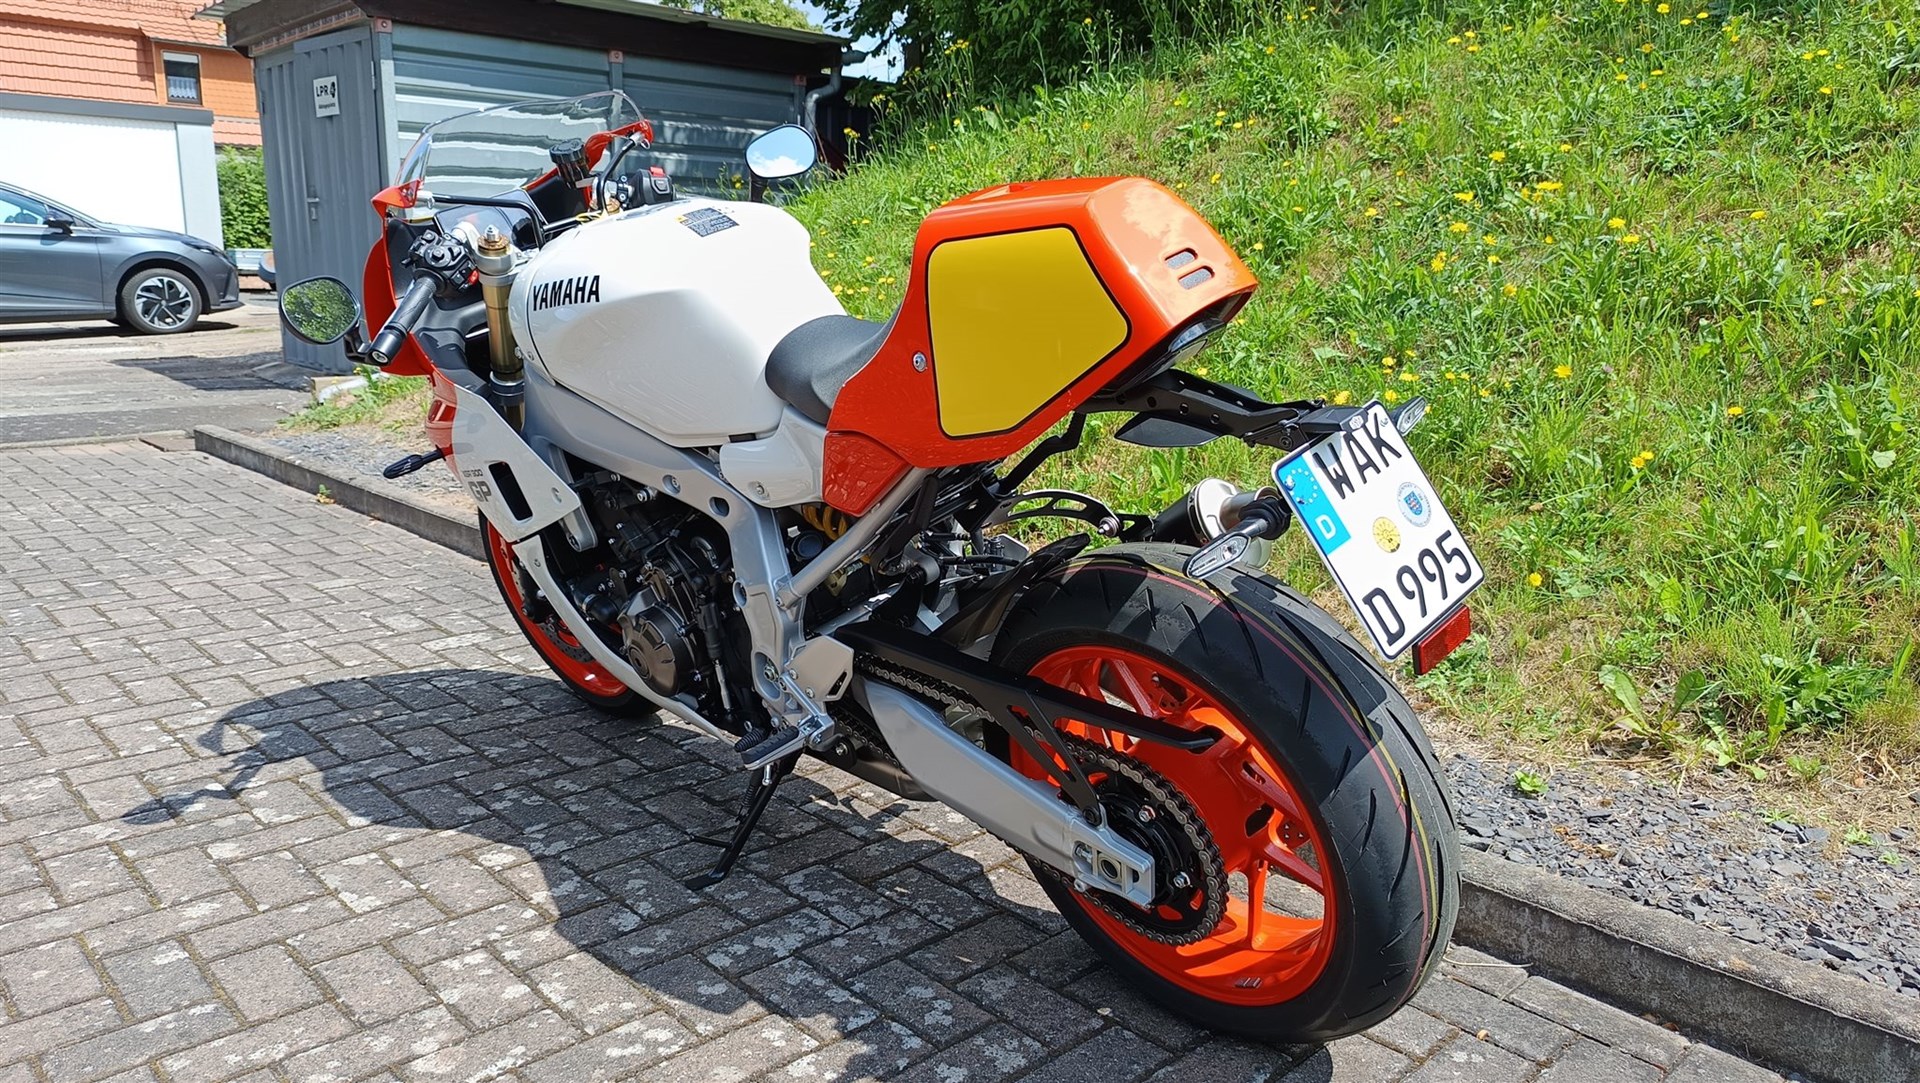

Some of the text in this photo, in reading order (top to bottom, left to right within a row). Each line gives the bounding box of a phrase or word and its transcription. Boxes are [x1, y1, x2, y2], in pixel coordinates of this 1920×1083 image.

[316, 85, 329, 97] LPR
[533, 275, 600, 311] YAMAHA
[1312, 412, 1402, 500] WAK
[468, 481, 491, 502] GP
[1315, 514, 1337, 541] D
[1362, 587, 1406, 647] D
[1396, 530, 1472, 618] 995
